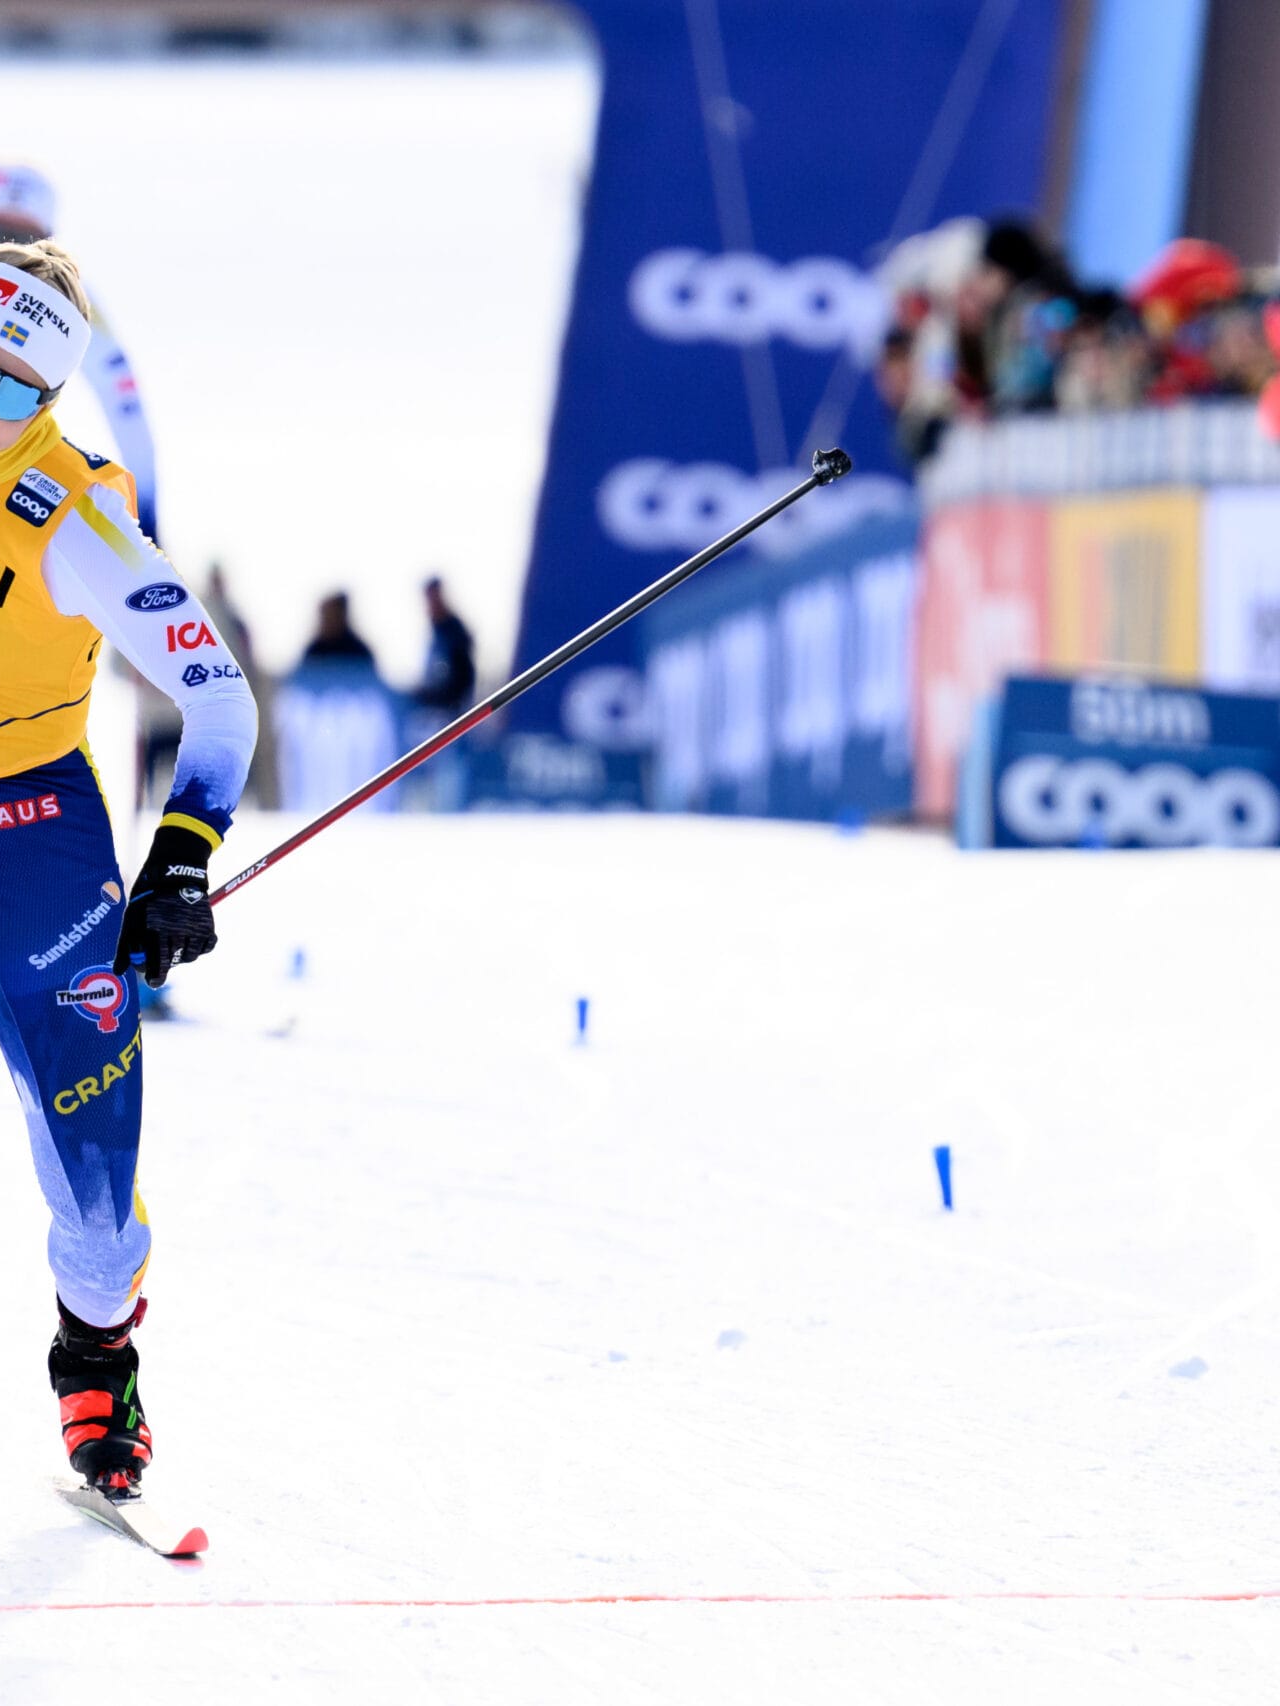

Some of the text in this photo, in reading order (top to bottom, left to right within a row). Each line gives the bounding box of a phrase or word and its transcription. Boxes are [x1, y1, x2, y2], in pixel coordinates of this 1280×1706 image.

[12, 301, 44, 328] SPEL
[18, 292, 71, 338] SVENSKA
[11, 491, 50, 519] coop
[140, 586, 180, 609] Ford
[166, 621, 217, 653] ICA
[29, 901, 111, 970] Sundström
[57, 986, 114, 1004] Thermia
[54, 1021, 142, 1114] CRAFT
